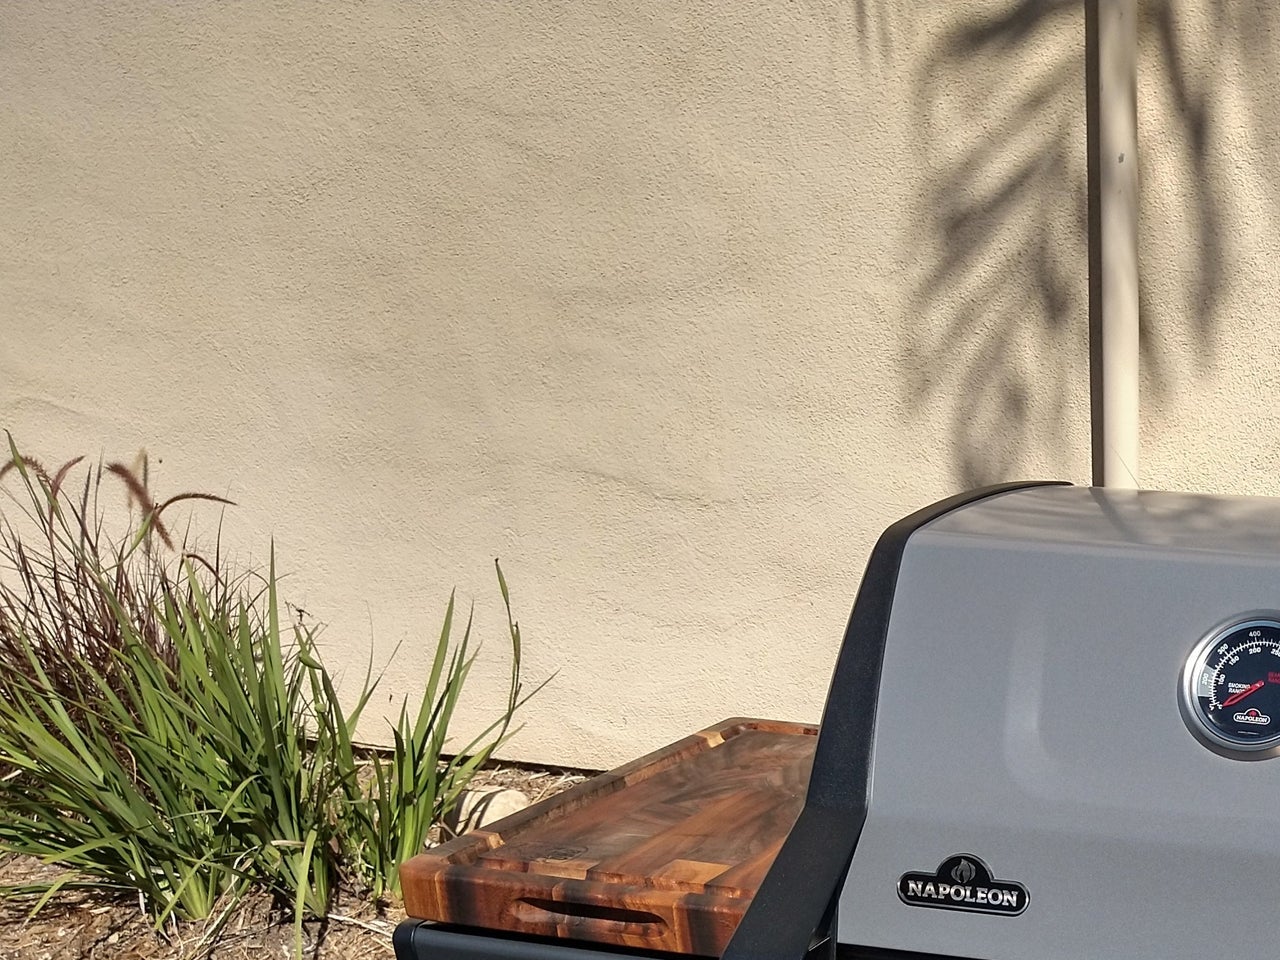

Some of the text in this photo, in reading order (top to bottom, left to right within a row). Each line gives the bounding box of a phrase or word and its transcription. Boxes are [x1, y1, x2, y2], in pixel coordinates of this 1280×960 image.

[1218, 643, 1229, 655] 300
[1249, 647, 1262, 655] 200
[1236, 715, 1268, 723] NAPOLEON
[907, 880, 1018, 907] NAPOLEON
